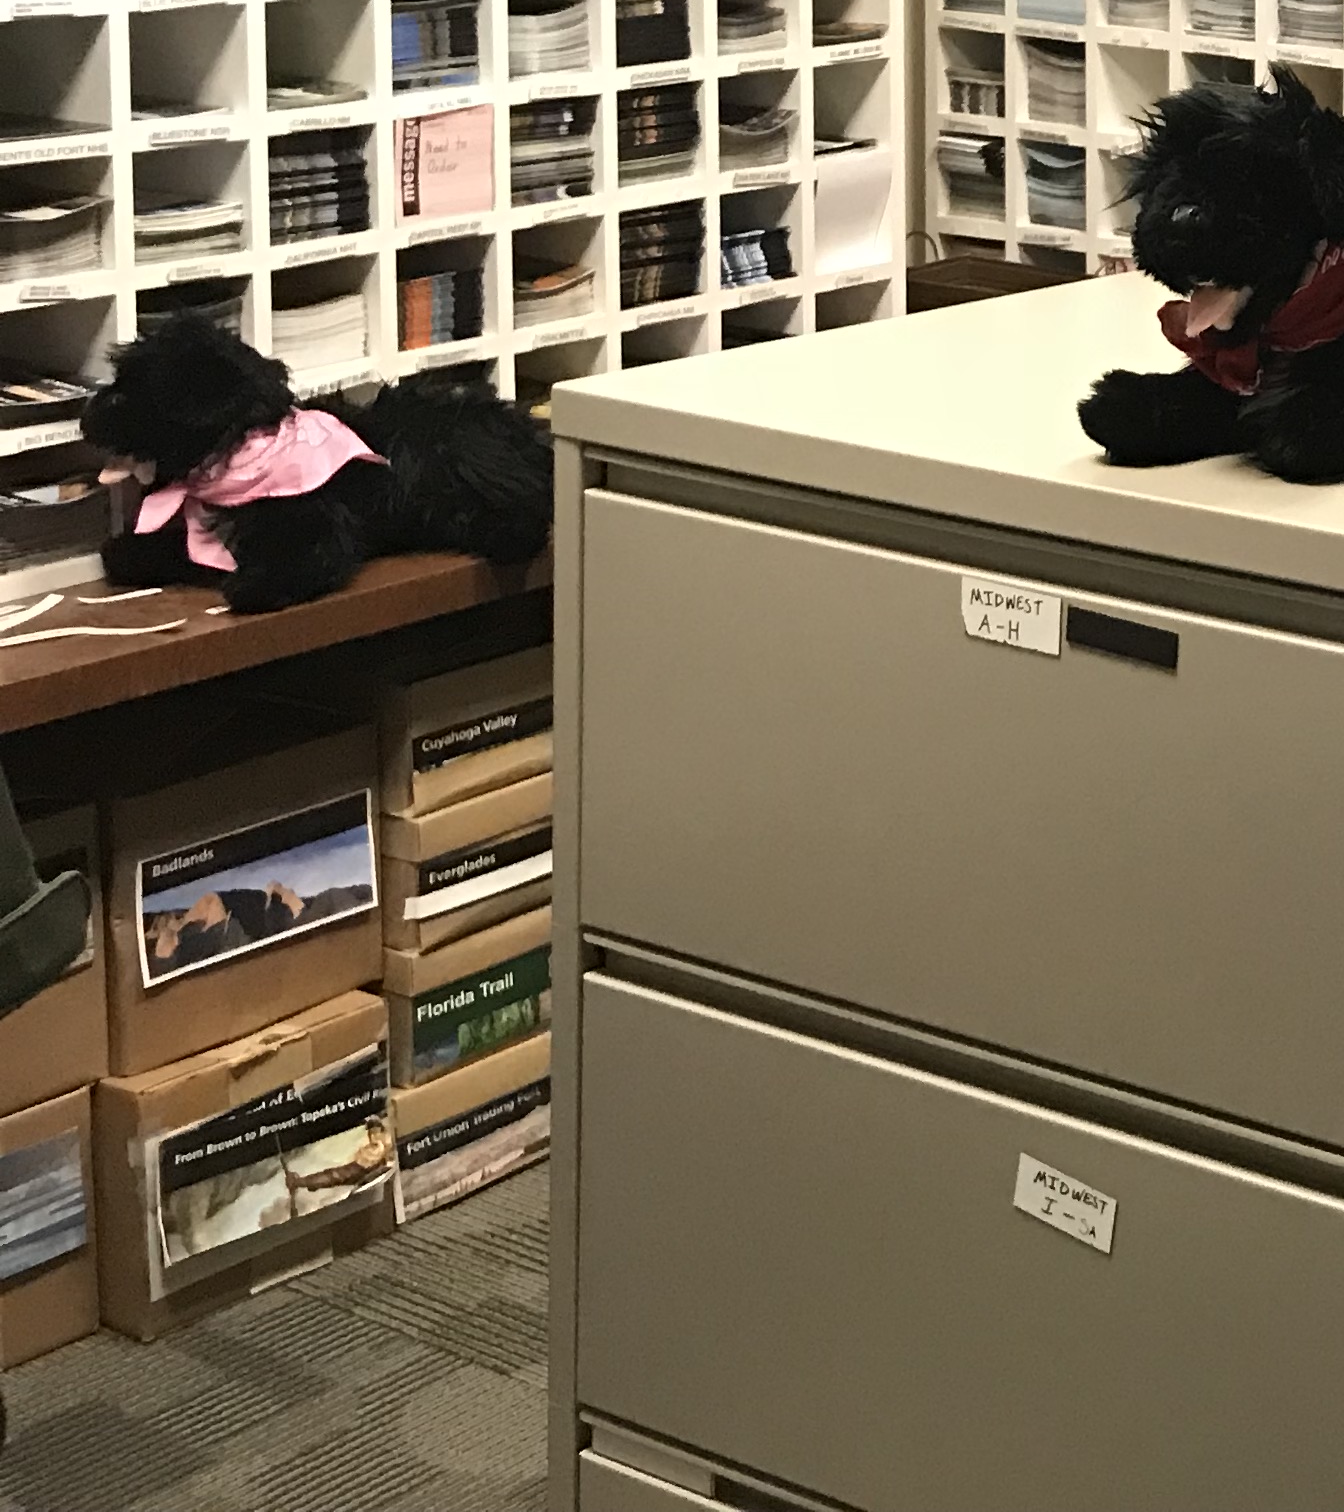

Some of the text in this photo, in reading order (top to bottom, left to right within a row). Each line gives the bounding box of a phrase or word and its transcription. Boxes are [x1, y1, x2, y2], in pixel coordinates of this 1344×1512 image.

[34, 148, 54, 158] OLD
[56, 145, 85, 157] FORT
[404, 119, 419, 203] message
[425, 139, 468, 154] Need to
[428, 159, 458, 174] Order
[25, 434, 42, 445] BIG
[969, 588, 1044, 617] MIDWEST
[421, 713, 518, 753] Cuyahoga Valley
[152, 848, 214, 877] Badlands
[429, 852, 496, 885] Everglades
[416, 971, 514, 1023] Florida Trail
[174, 1148, 203, 1166] From
[206, 1130, 243, 1154] Brown
[244, 1128, 257, 1142] to
[300, 1098, 346, 1126] Topeka's
[347, 1089, 371, 1110] Civil
[406, 1135, 432, 1156] Fort
[432, 1120, 471, 1144] Union
[1032, 1169, 1109, 1216] MIDWEST
